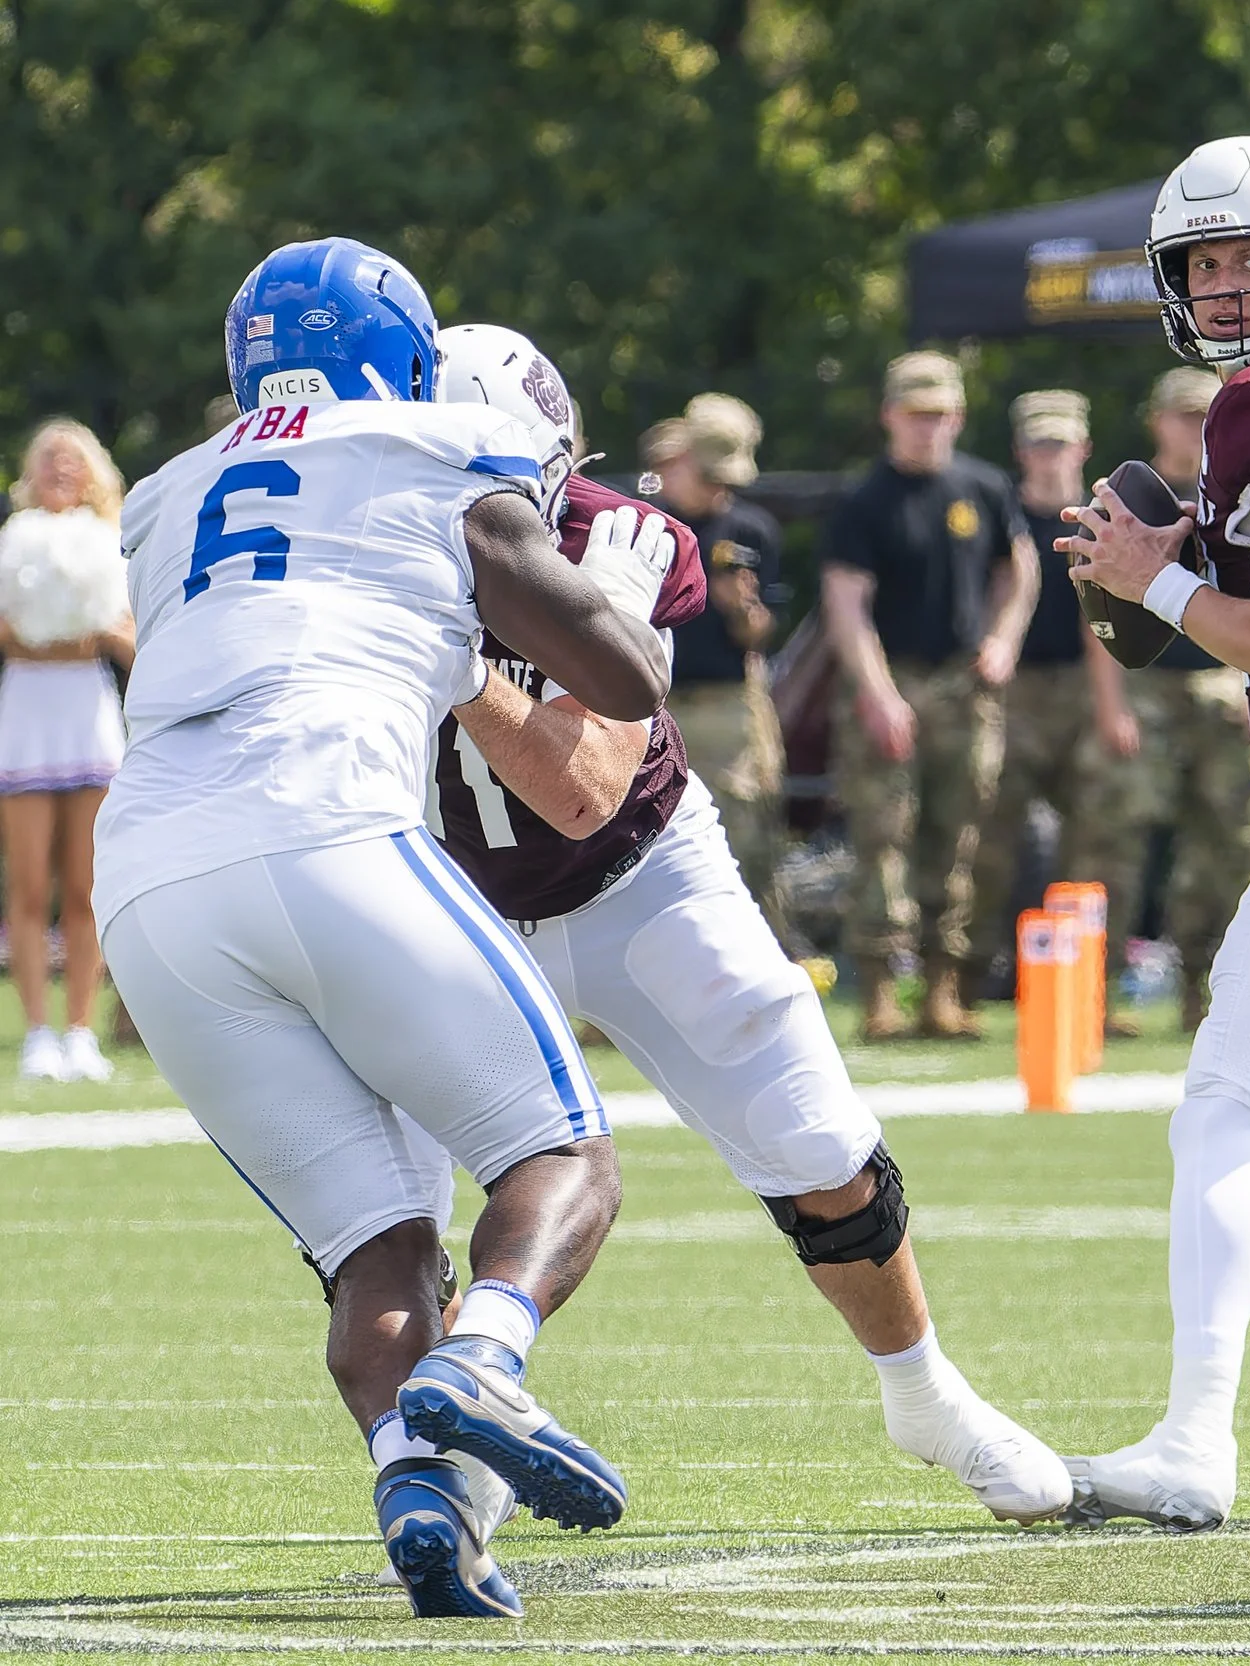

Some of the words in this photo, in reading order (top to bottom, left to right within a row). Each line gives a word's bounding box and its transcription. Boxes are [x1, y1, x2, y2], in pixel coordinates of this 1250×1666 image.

[1186, 214, 1227, 228] BEARS
[304, 314, 332, 325] ACC
[263, 378, 321, 399] VICIS
[219, 405, 310, 455] M'BA
[182, 459, 302, 606] 6
